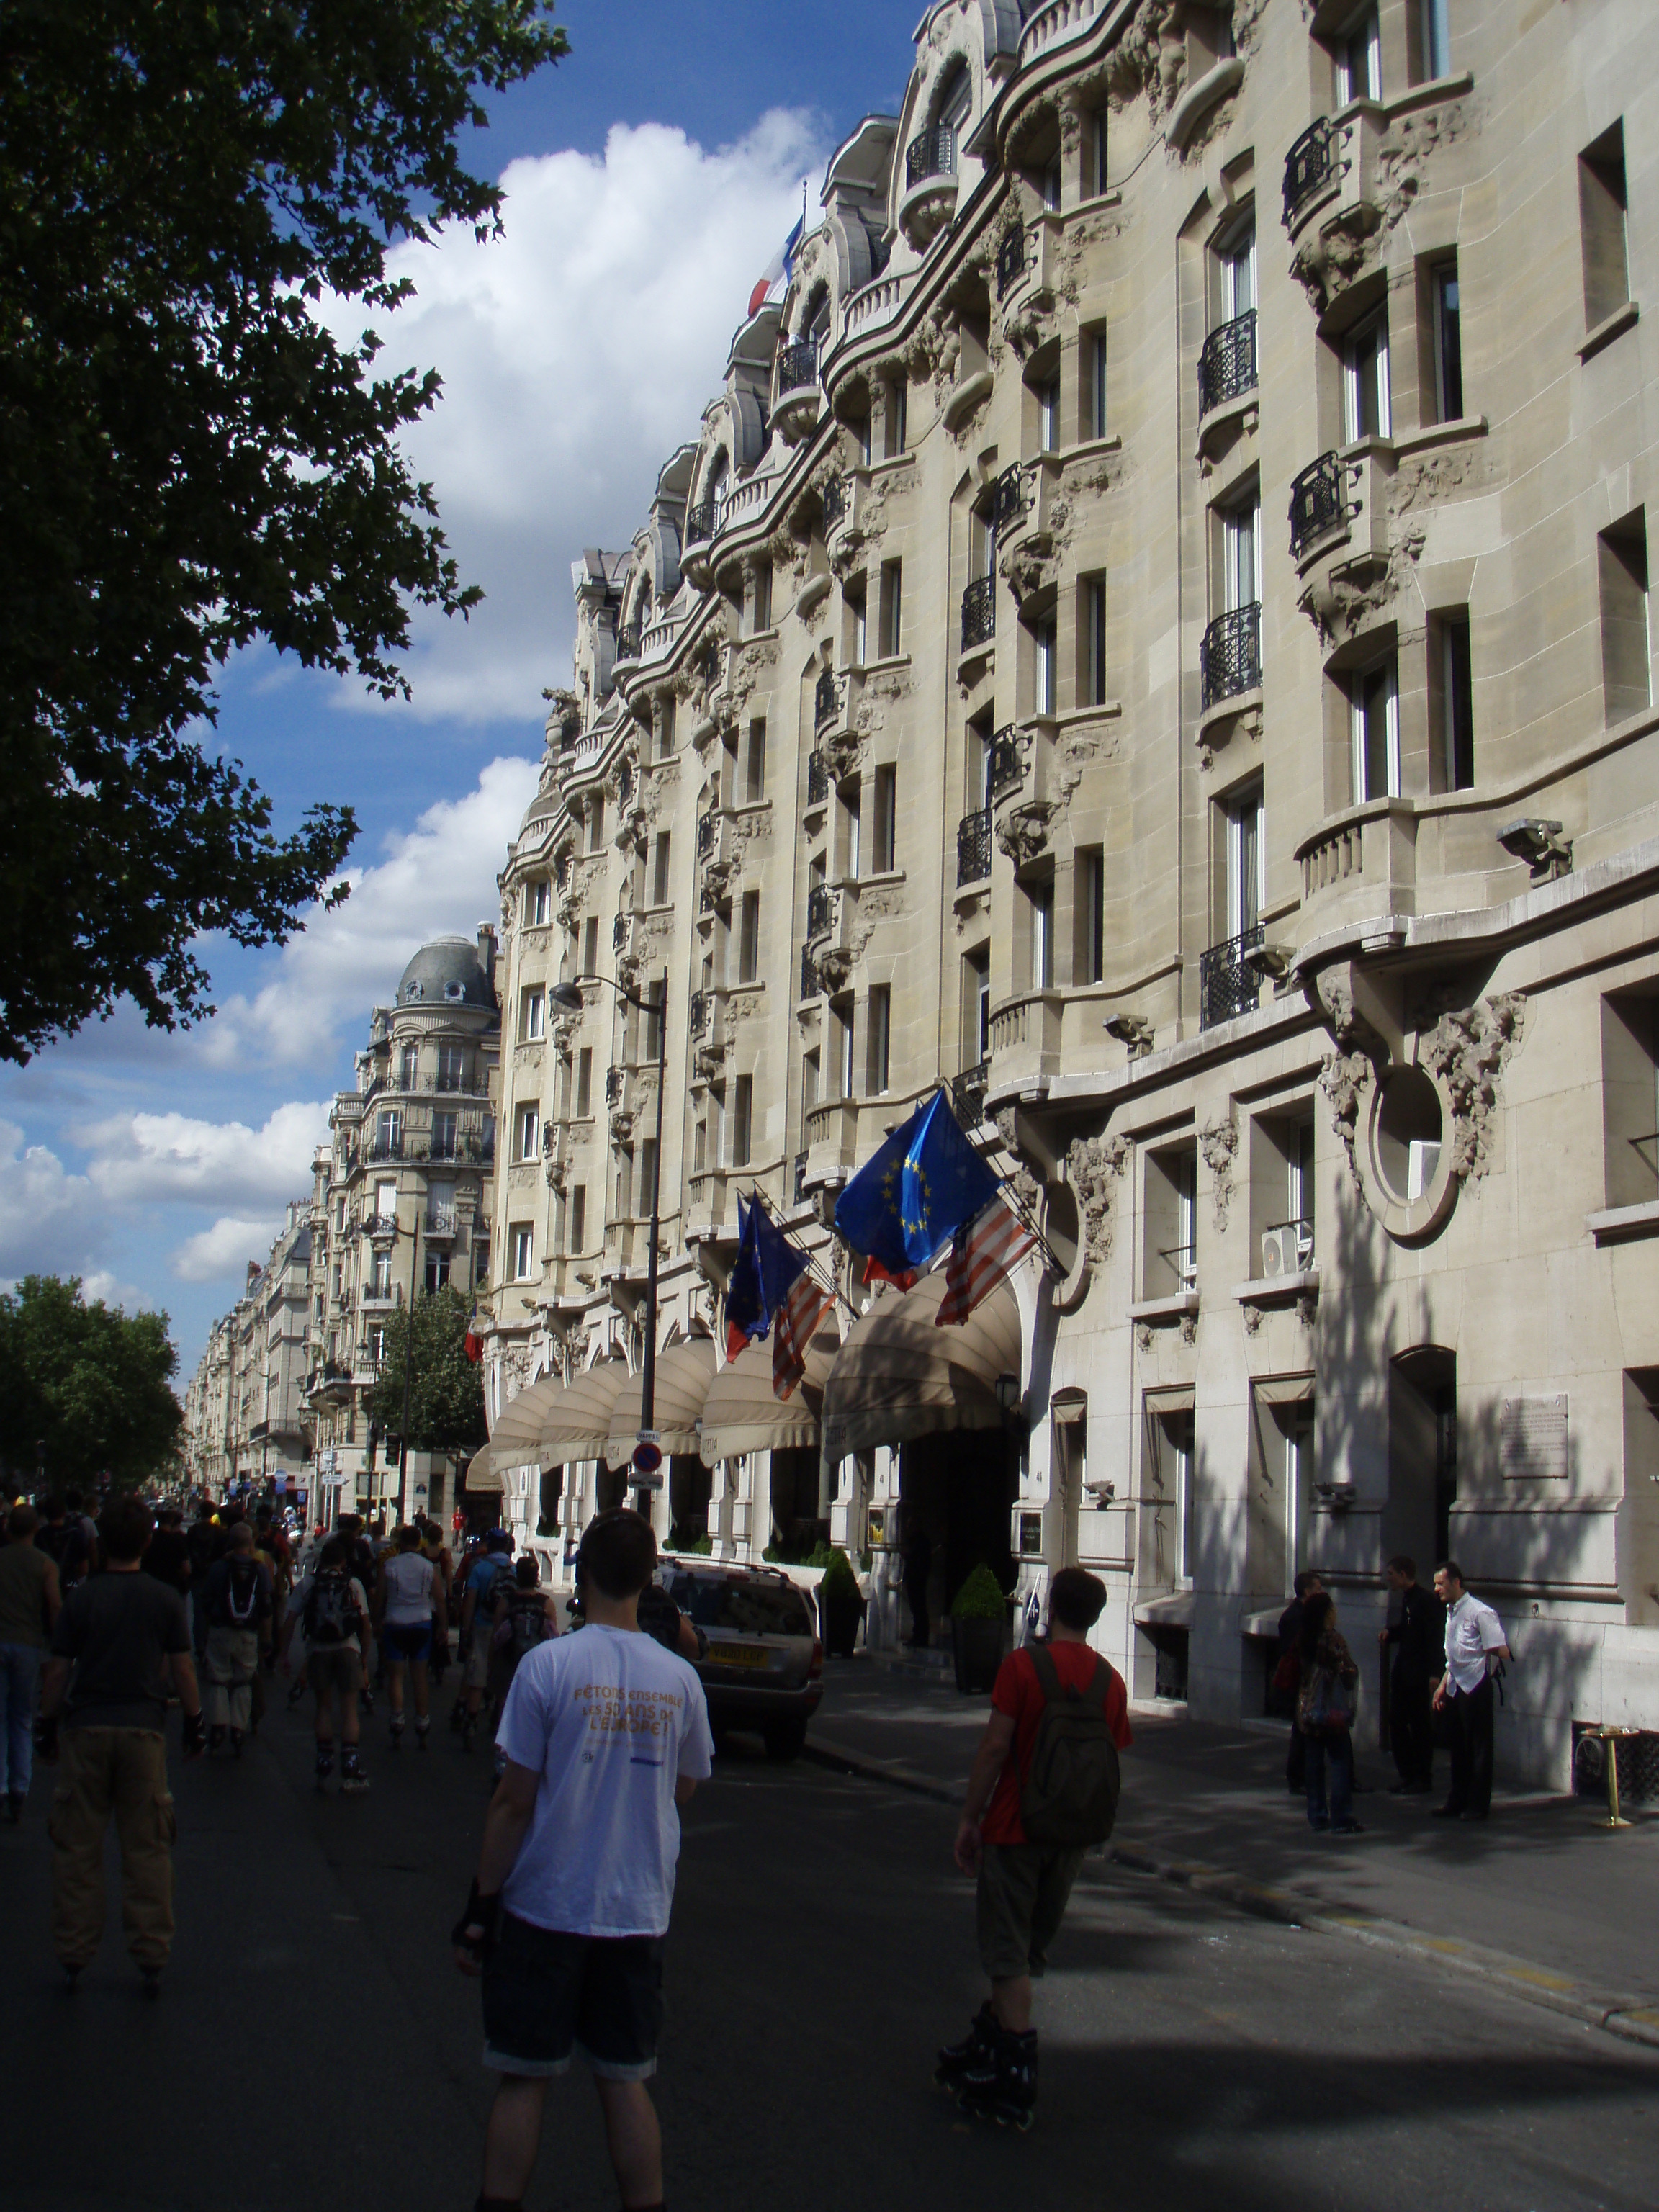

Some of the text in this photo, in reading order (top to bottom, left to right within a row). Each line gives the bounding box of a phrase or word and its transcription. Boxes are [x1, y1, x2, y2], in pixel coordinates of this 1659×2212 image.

[583, 1704, 601, 1716] LES
[604, 1701, 621, 1717] 50
[625, 1703, 656, 1720] ANS
